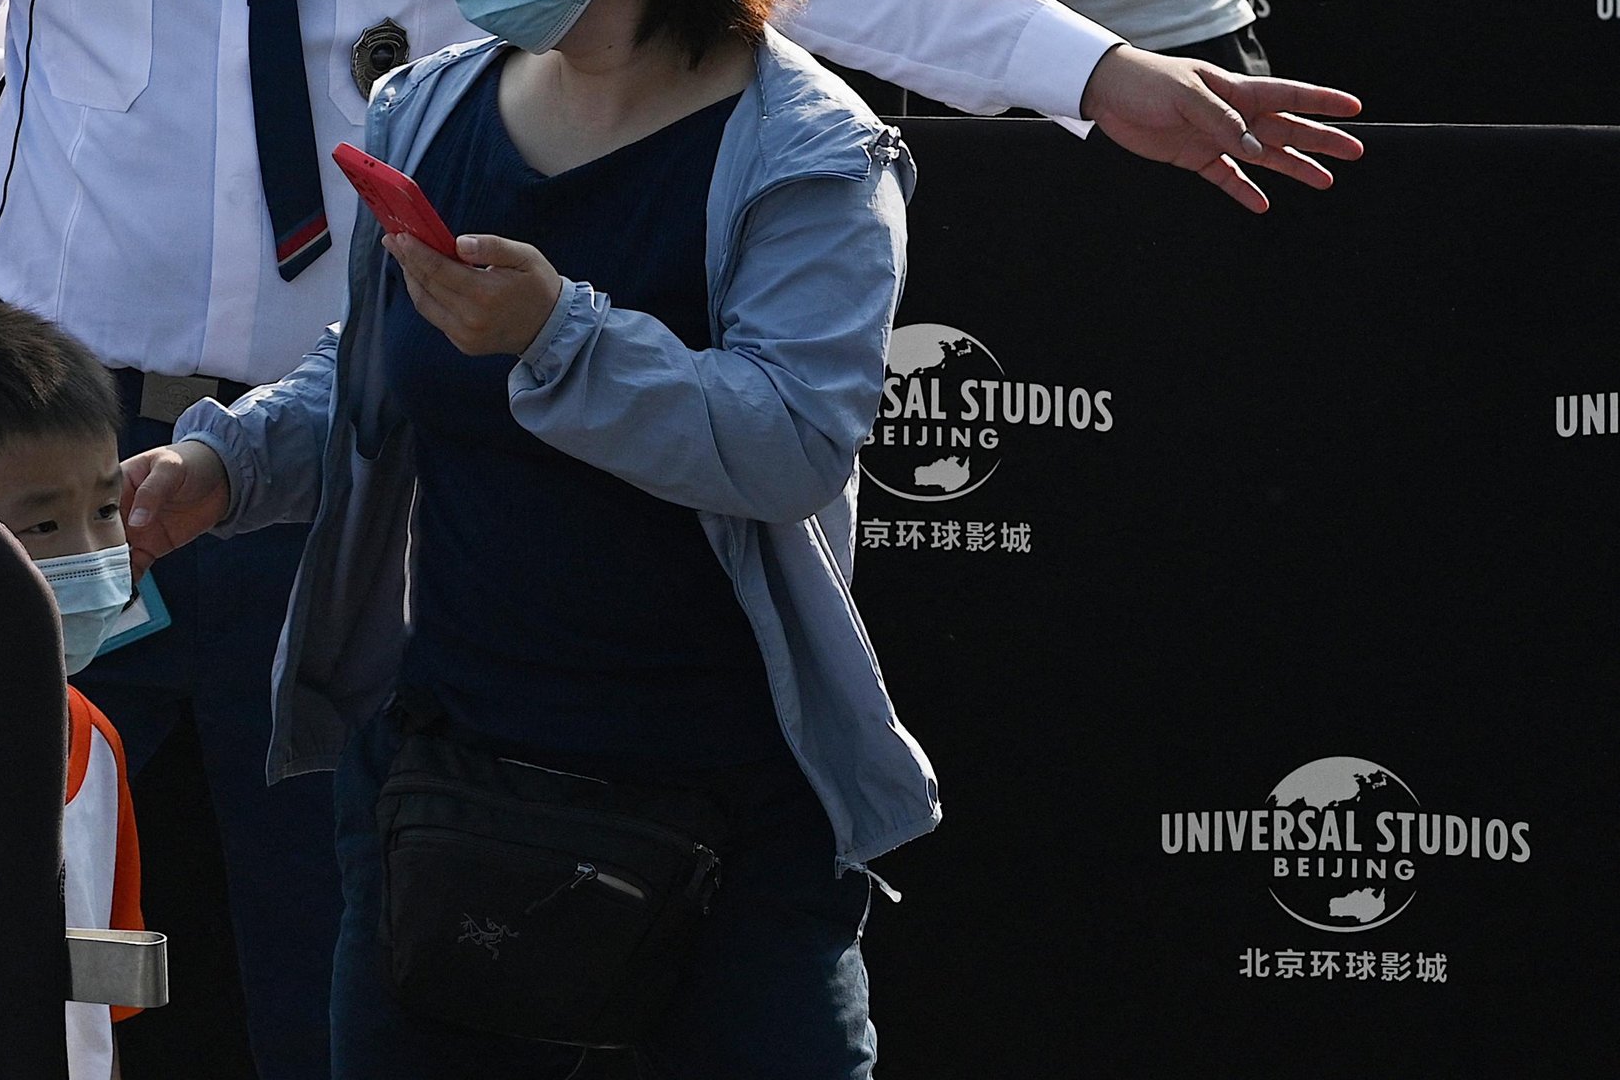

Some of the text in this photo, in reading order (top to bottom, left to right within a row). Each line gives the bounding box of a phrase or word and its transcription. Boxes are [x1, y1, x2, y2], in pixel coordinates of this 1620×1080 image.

[876, 377, 1114, 432] SAL STUDIOS
[1555, 391, 1620, 438] UNI
[860, 517, 1032, 554] 京环球影城
[1161, 809, 1531, 863] UNIVERSAL STUDIOS
[1273, 857, 1416, 881] BEIJING
[1239, 947, 1448, 984] 北京环球影城
